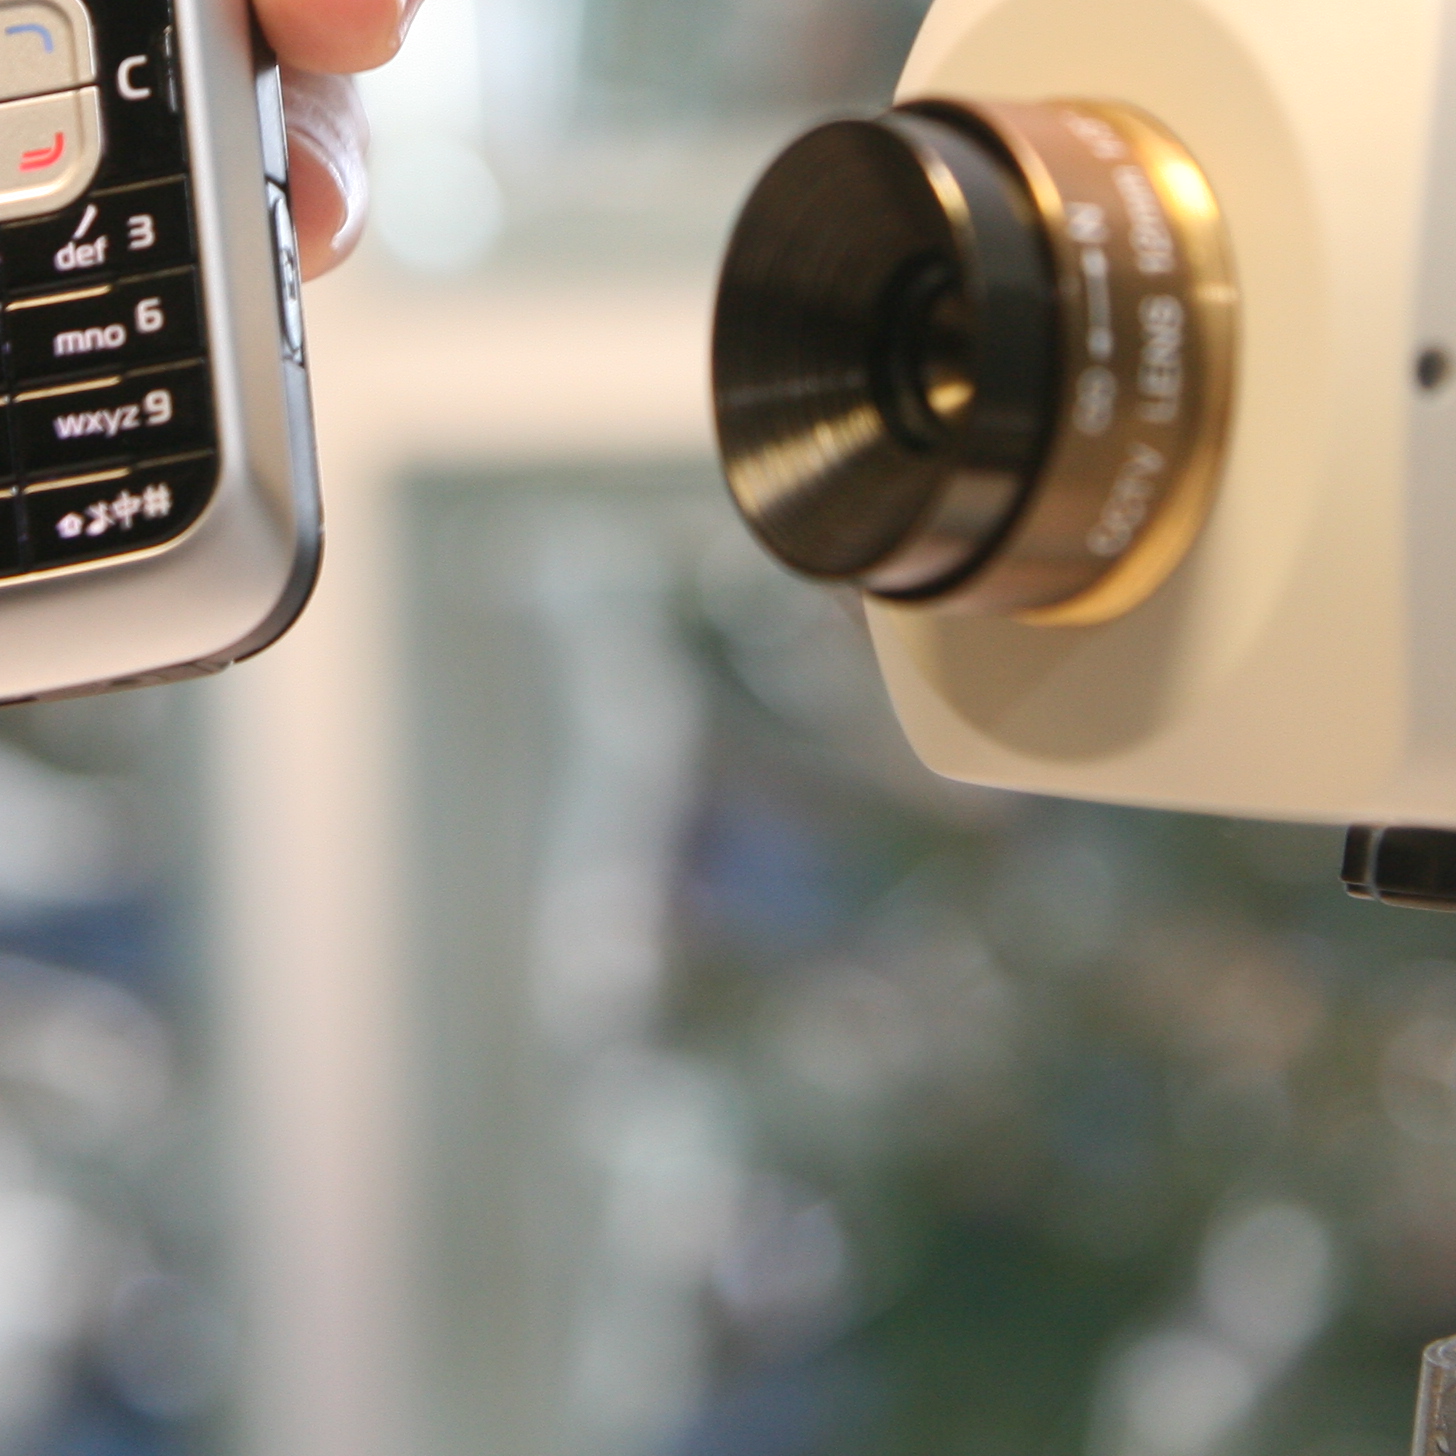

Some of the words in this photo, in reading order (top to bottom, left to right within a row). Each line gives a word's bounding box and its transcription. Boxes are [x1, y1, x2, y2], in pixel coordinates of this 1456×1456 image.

[117, 54, 151, 101] C
[53, 235, 108, 272] def
[127, 213, 156, 250] 3
[53, 324, 127, 357] mno
[135, 296, 165, 334] 6
[1137, 294, 1184, 424] LENS
[54, 404, 140, 440] wxyz
[143, 388, 173, 426] 9
